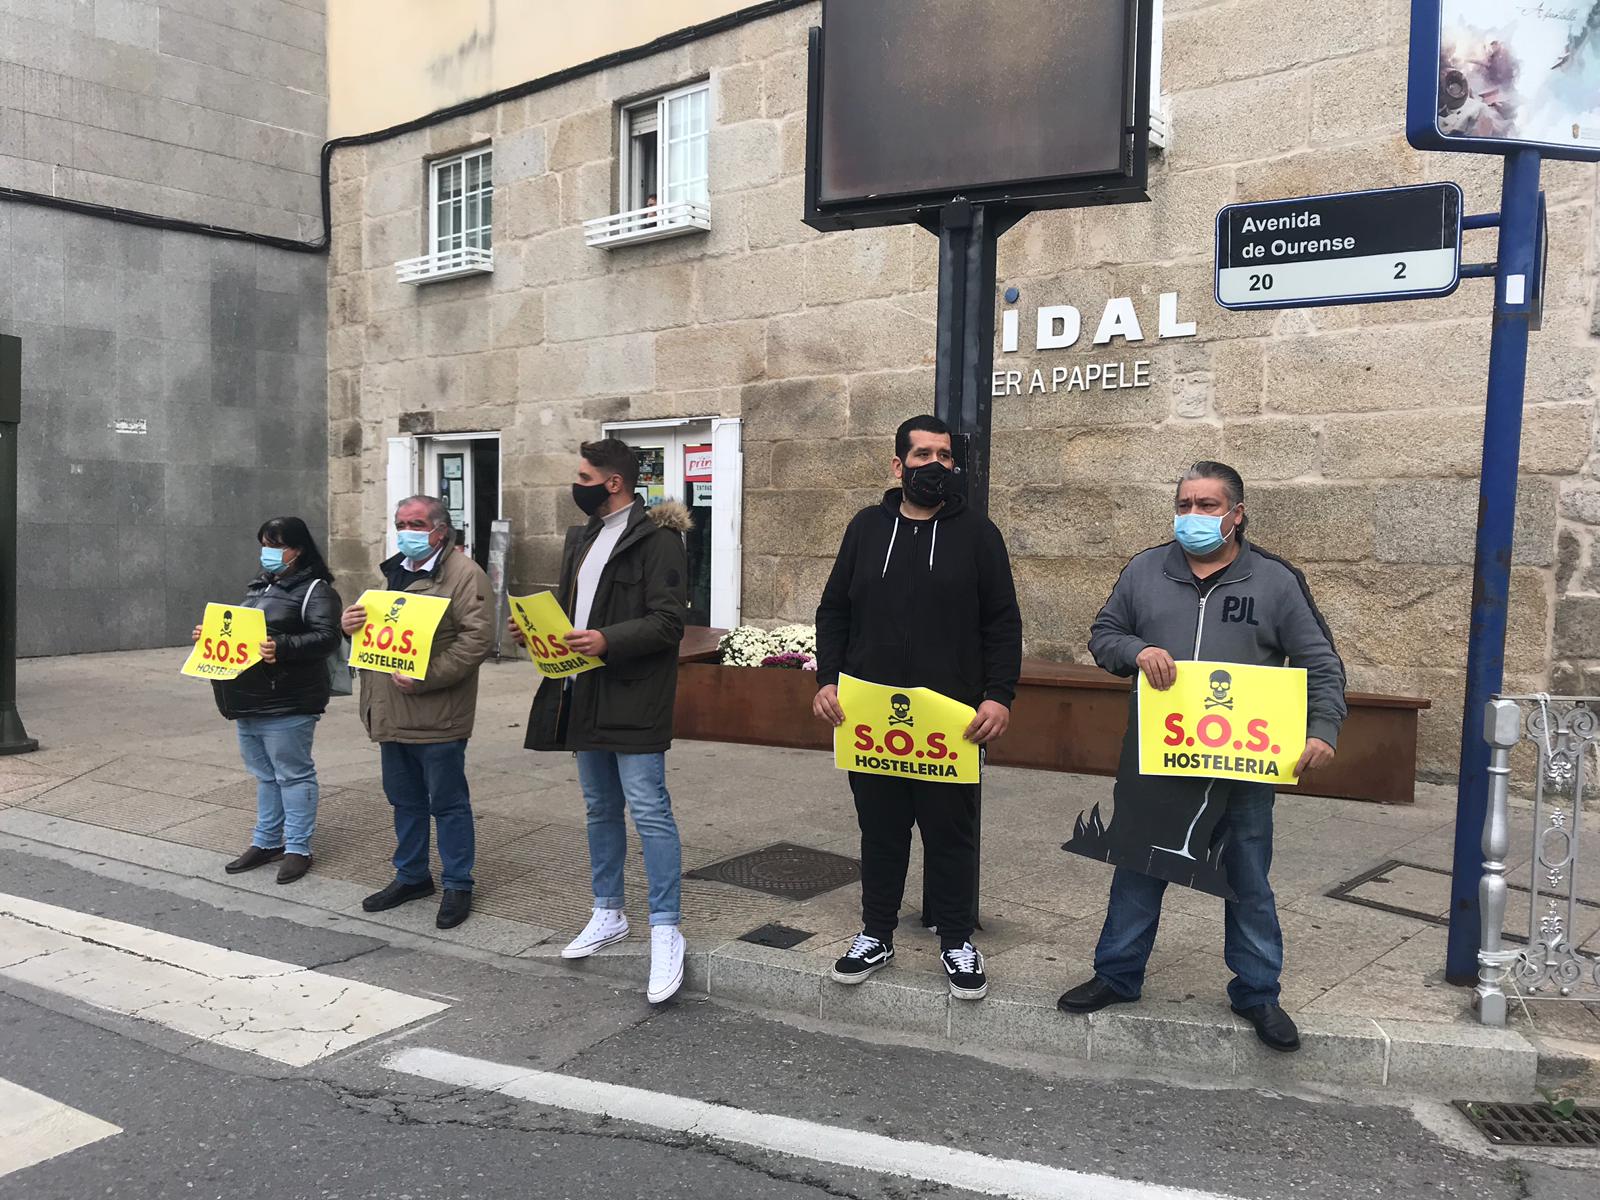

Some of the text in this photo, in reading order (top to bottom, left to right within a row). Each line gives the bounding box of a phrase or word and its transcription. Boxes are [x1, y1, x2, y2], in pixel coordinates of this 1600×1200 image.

[1241, 211, 1321, 234] Avenida
[1242, 234, 1356, 259] de Ourense
[1248, 261, 1407, 292] 20 2
[1052, 360, 1151, 392] PAPELE
[1221, 596, 1259, 626] PJL
[362, 623, 417, 656] S.O.S.
[358, 651, 415, 672] HOSTELERIA
[854, 723, 958, 761] S.O.S.
[1163, 712, 1281, 755] S.O.S.
[854, 754, 958, 778] HOSTELERIA
[1163, 752, 1280, 776] HOSTELERIA
